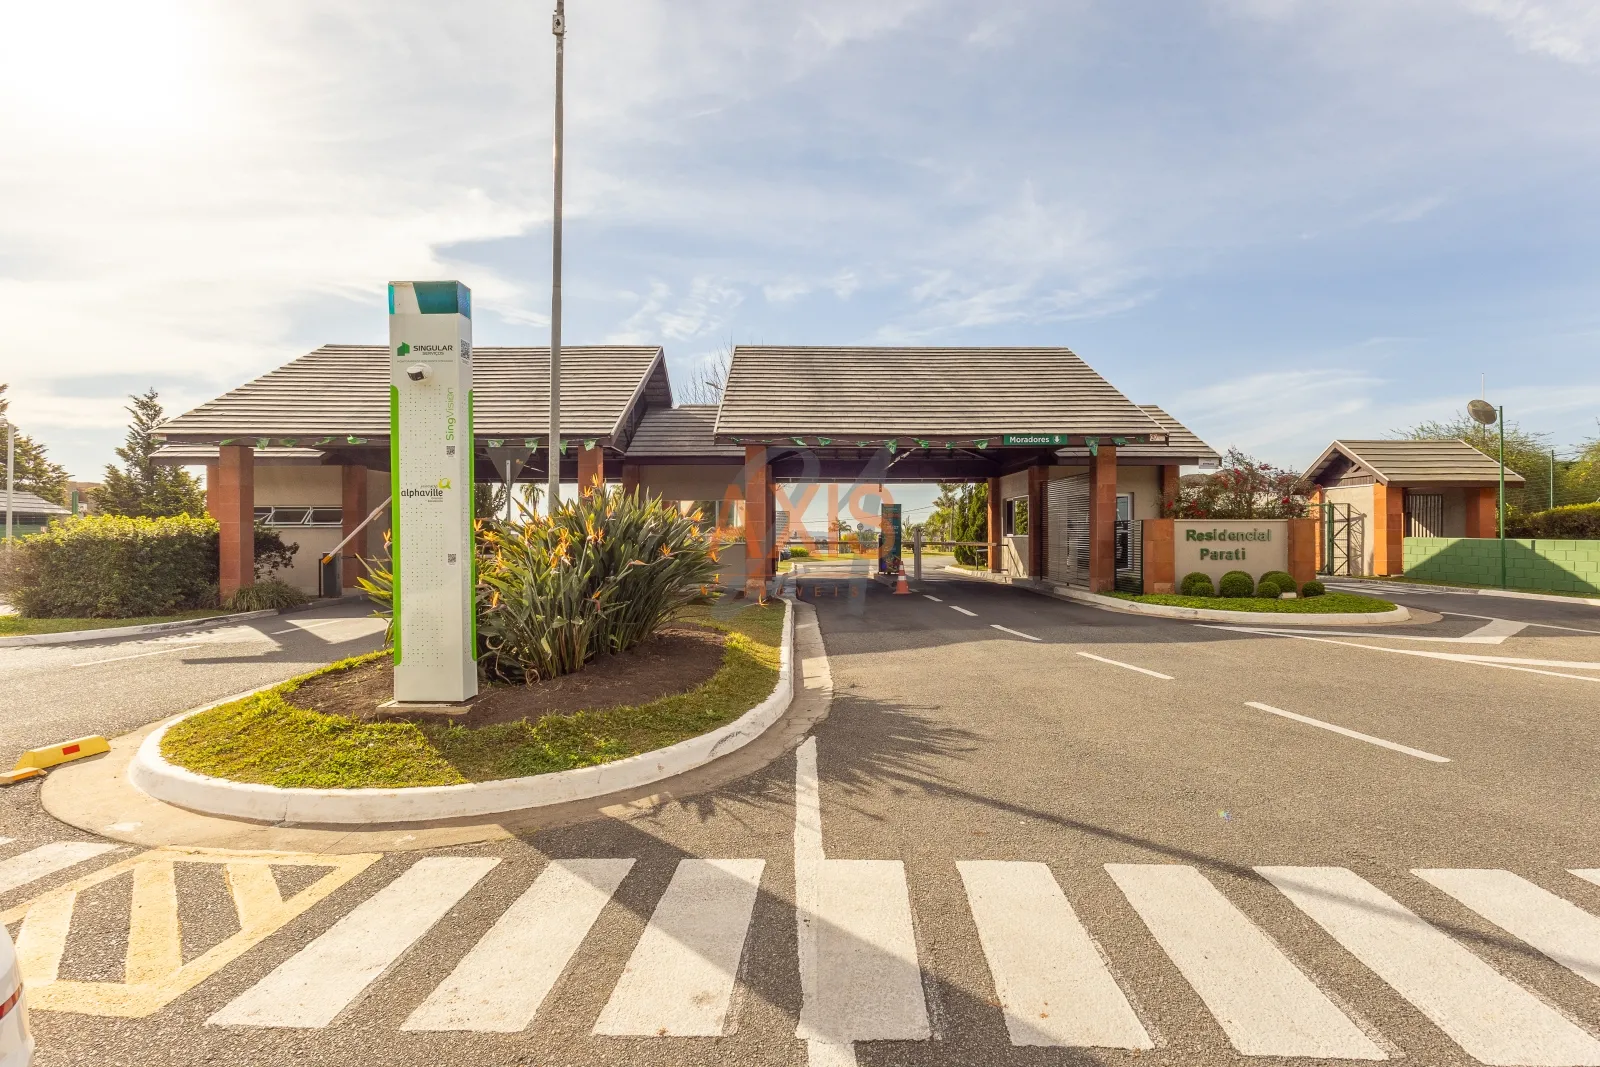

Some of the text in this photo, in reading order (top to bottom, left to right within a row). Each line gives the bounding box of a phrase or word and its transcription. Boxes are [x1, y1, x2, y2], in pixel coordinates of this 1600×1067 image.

[445, 387, 457, 441] SingVision
[400, 488, 444, 499] alphaville
[1185, 528, 1272, 542] Residencial
[1199, 547, 1246, 561] Parati
